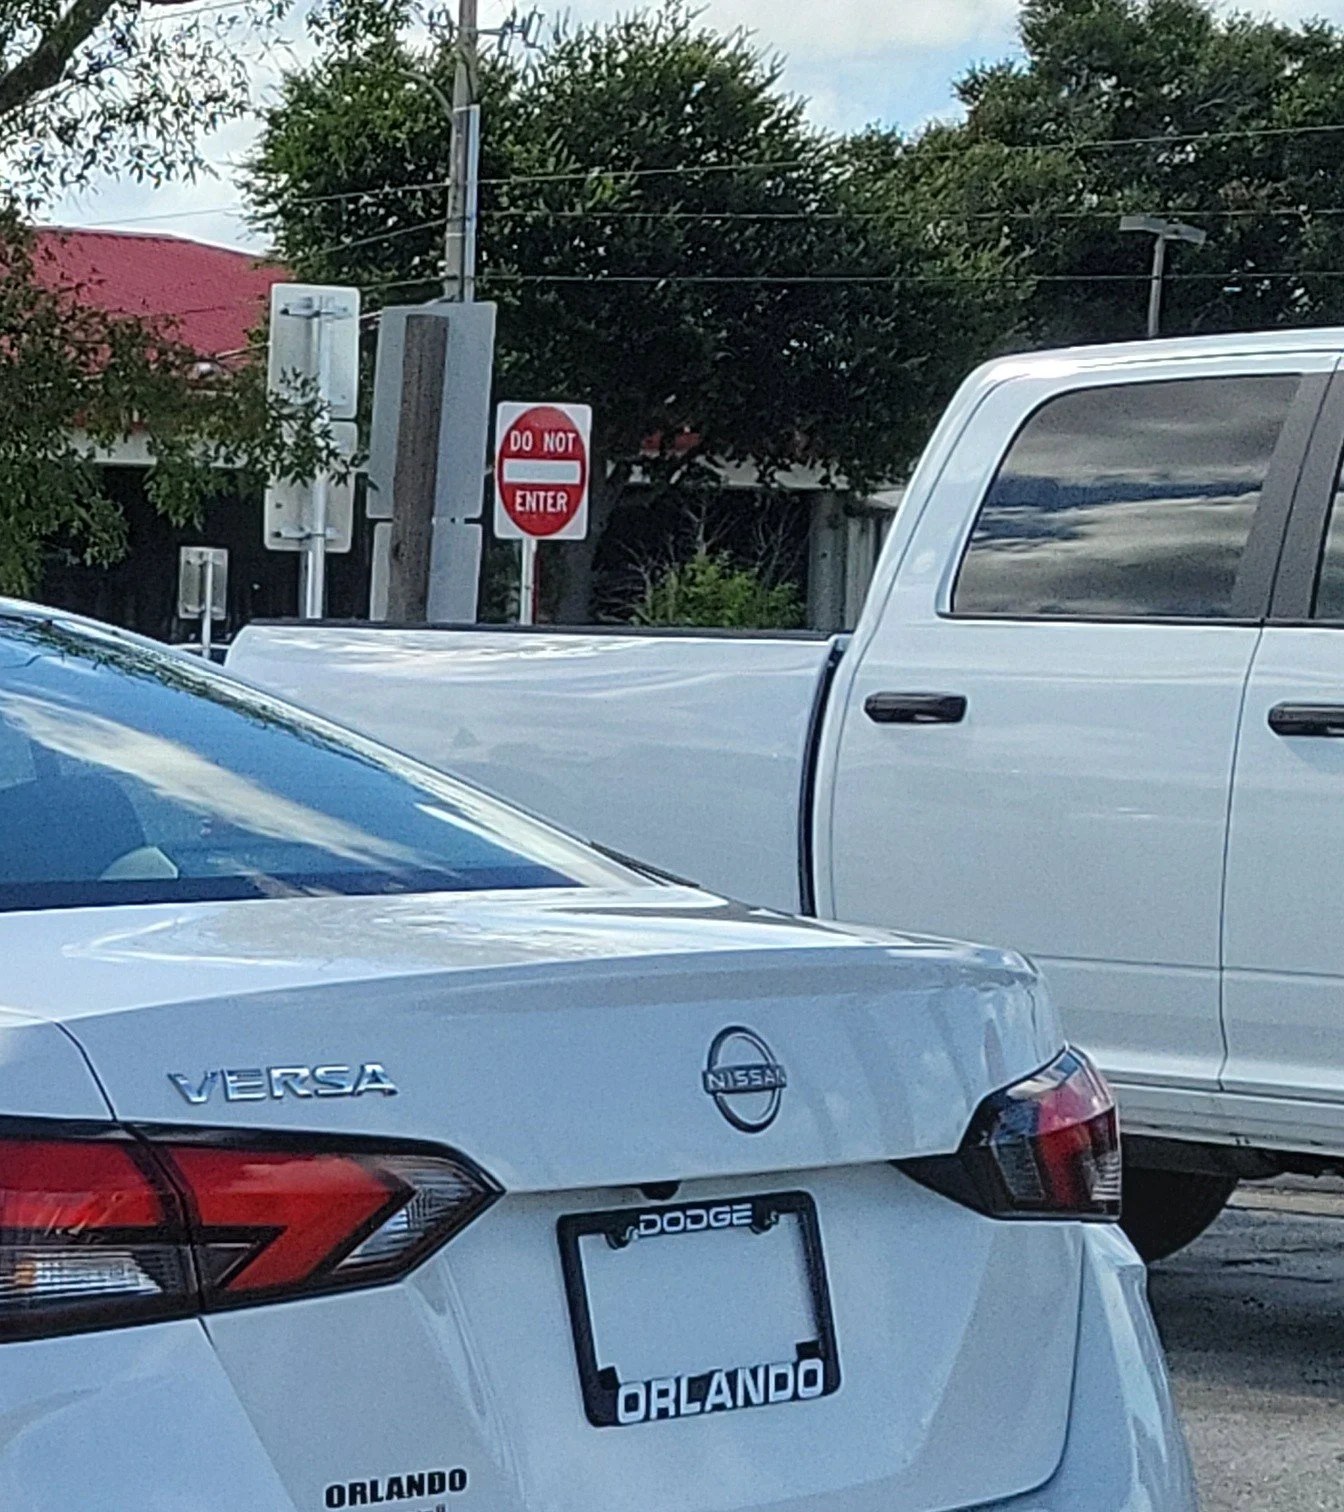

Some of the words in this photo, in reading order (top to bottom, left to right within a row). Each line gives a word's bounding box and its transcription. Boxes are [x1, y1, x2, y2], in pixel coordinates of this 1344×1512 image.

[510, 430, 533, 452] DO
[543, 431, 576, 453] NOT
[515, 490, 568, 513] ENTER
[166, 1062, 399, 1105] VERSA
[638, 1203, 753, 1235] DODGE
[616, 1358, 825, 1424] ORLANDO
[325, 1468, 467, 1509] ORLANDO
